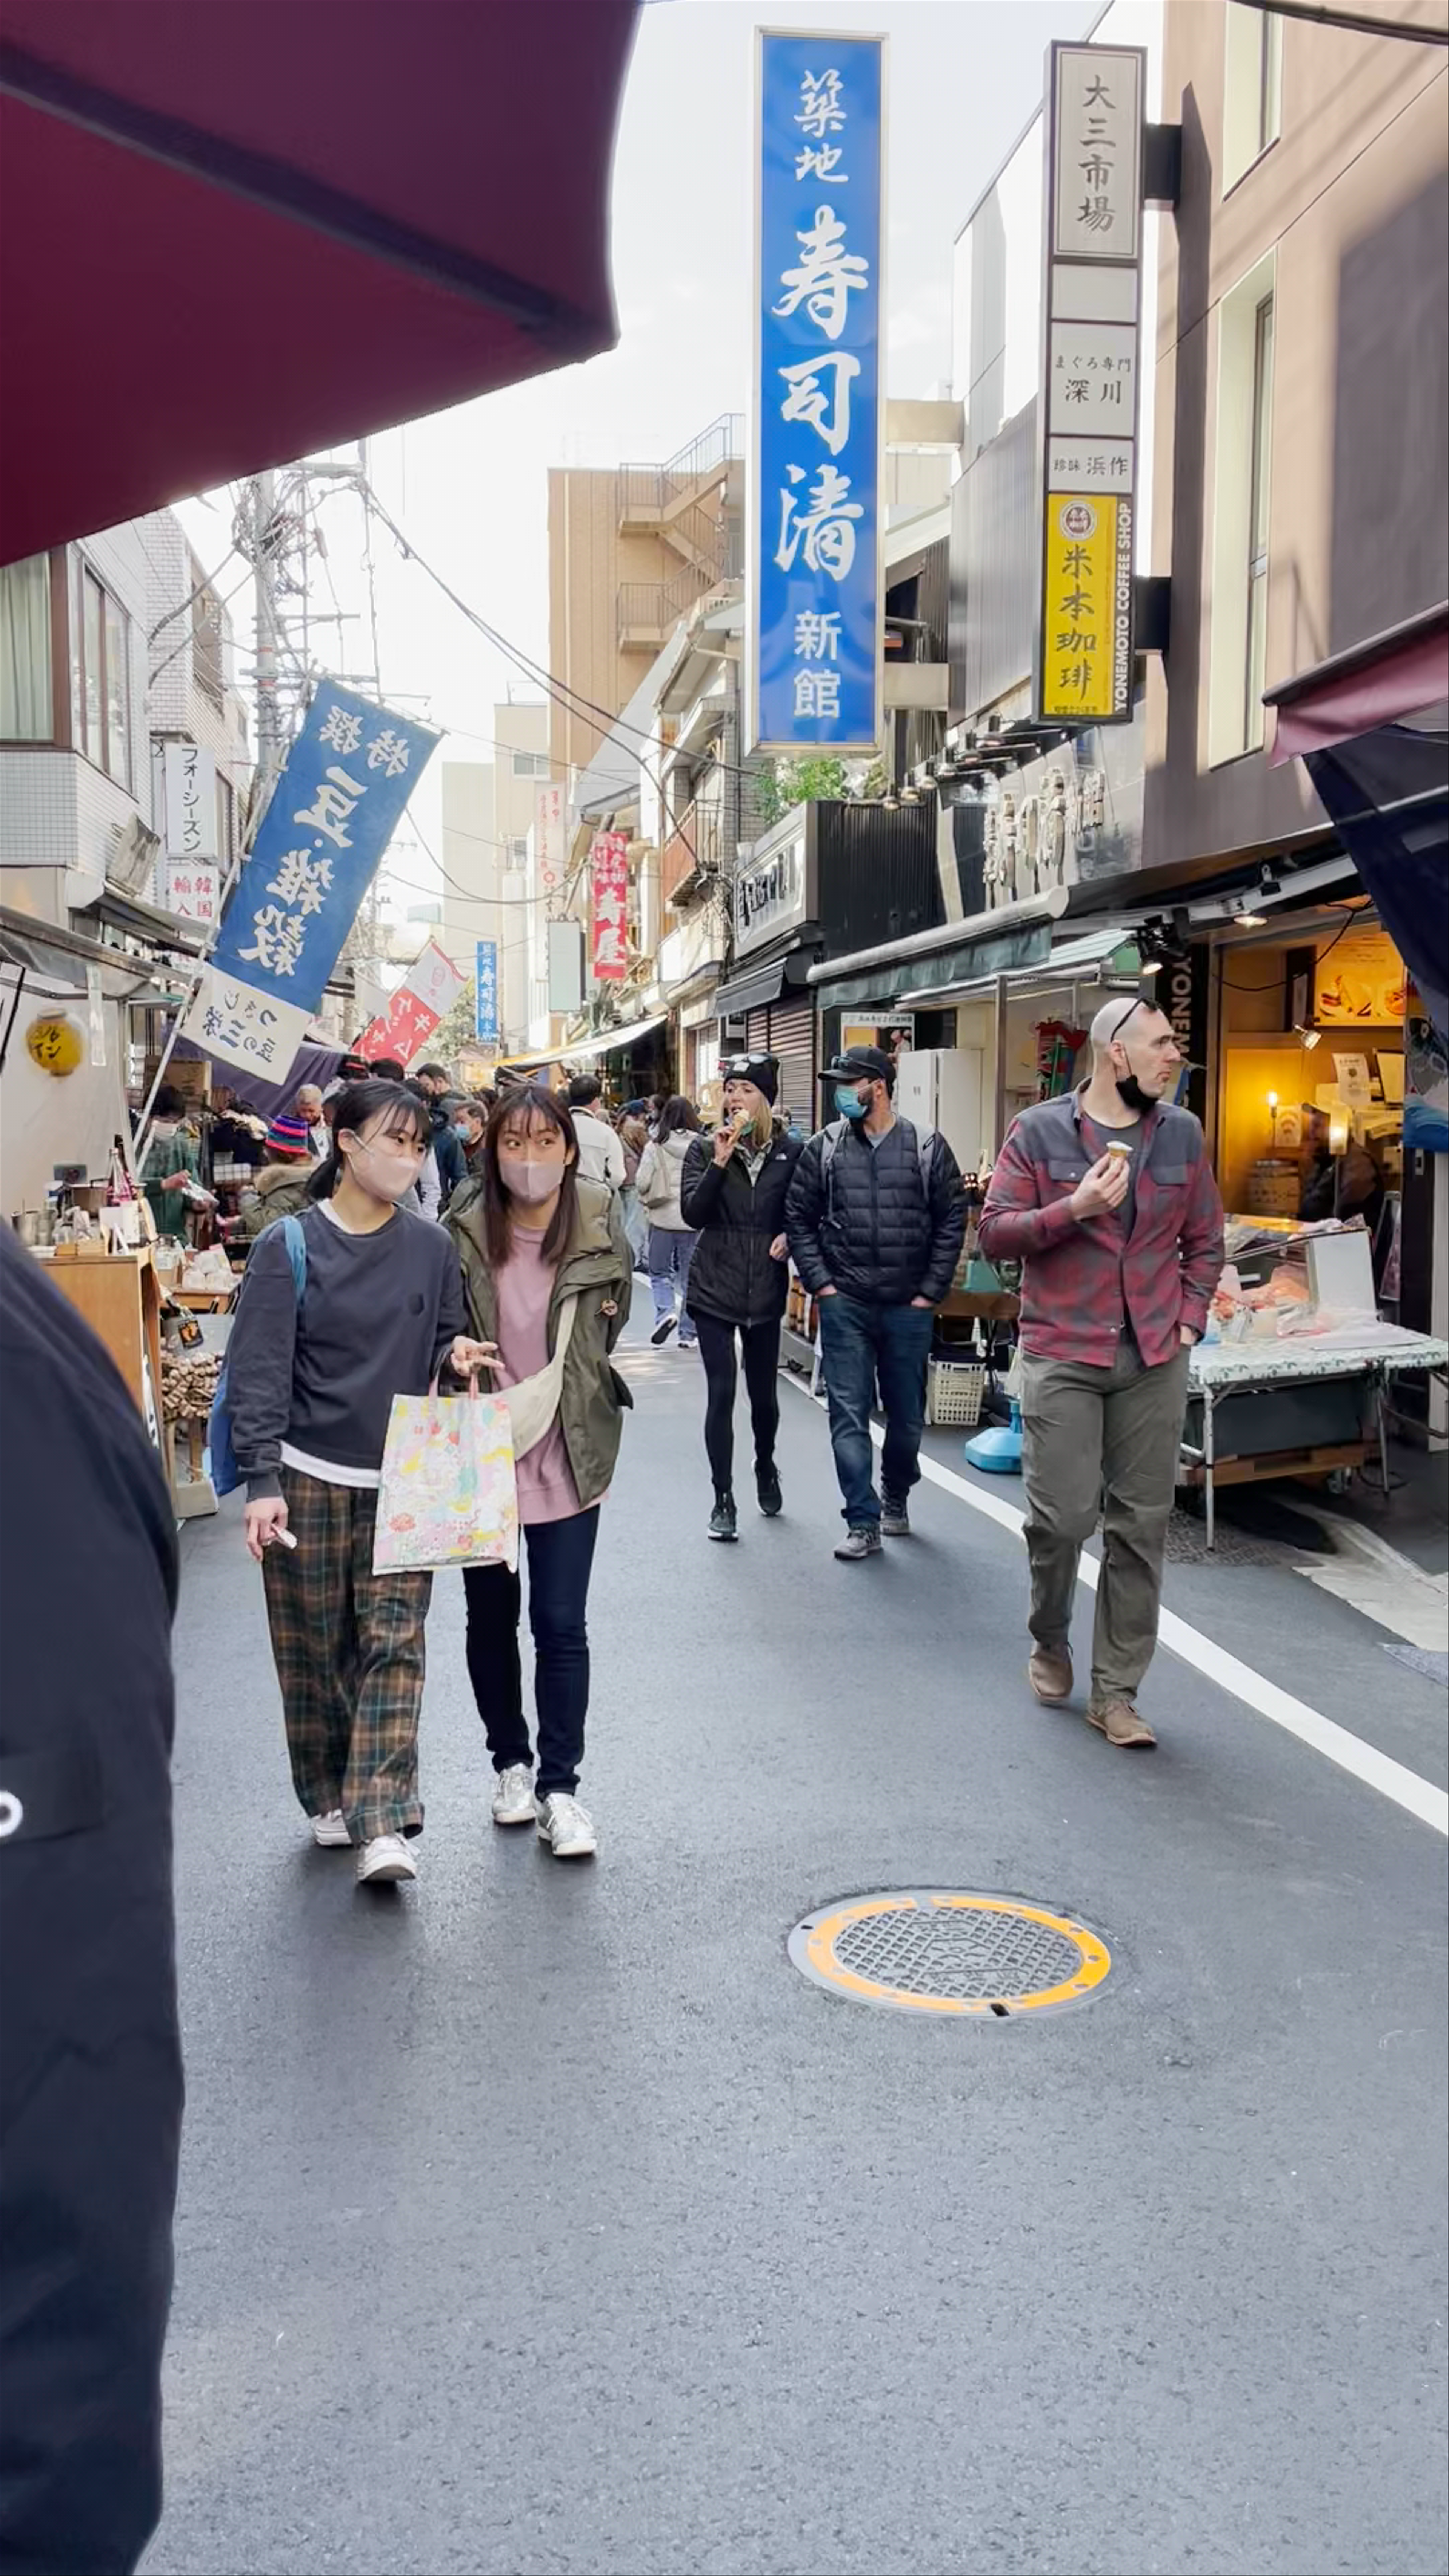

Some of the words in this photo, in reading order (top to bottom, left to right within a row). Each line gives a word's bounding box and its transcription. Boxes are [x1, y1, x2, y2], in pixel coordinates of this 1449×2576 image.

[793, 69, 848, 184] 築地
[1076, 74, 1118, 233] 大三市場
[771, 203, 870, 583] 寿司清
[1055, 355, 1131, 373] まぐろ専門
[1065, 378, 1121, 404] 深川
[1086, 456, 1128, 477] 浜作
[1118, 503, 1132, 549] SHOP
[1055, 543, 1097, 701] 米本珈琲
[1117, 552, 1131, 611] COFFEE
[793, 610, 842, 720] 新館
[1115, 615, 1130, 711] YONEMOTO
[181, 748, 201, 853] フォーシーズン
[194, 875, 213, 918] 韓国
